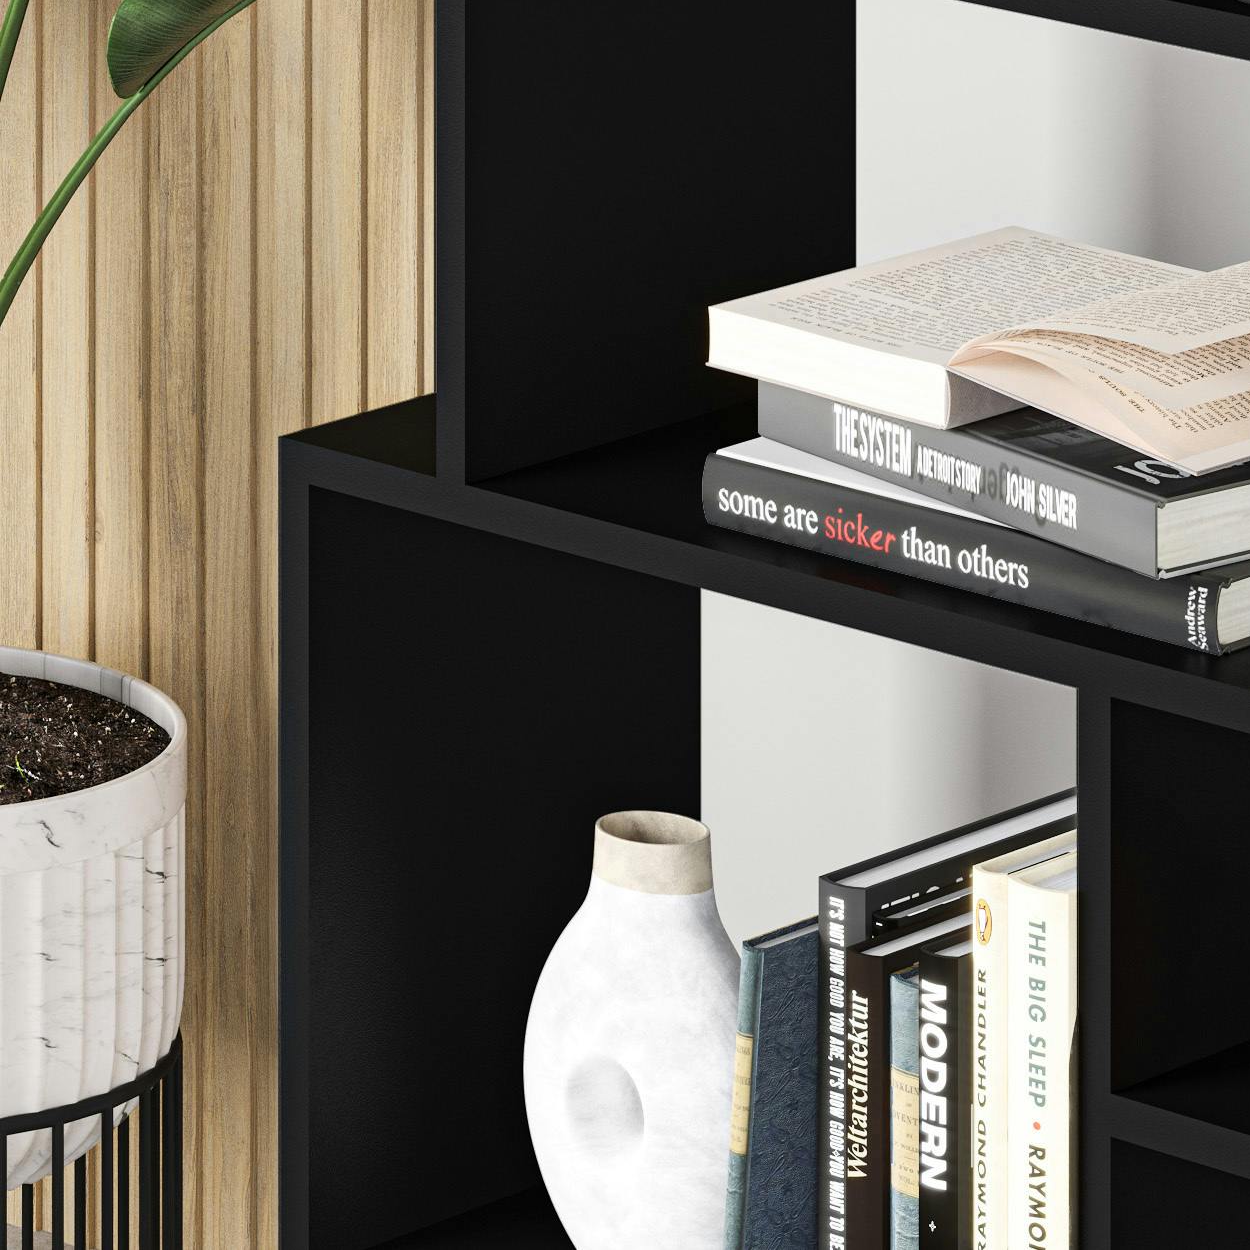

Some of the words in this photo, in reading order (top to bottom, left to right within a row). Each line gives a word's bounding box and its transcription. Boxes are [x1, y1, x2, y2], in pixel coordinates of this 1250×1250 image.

[833, 403, 858, 458] THE
[859, 412, 912, 478] SYSTEM
[1006, 471, 1036, 515] JOHN
[1038, 483, 1078, 530] SILVER
[717, 487, 778, 524] some
[783, 503, 819, 535] are
[824, 507, 897, 554] sicker
[901, 526, 952, 570] than
[957, 543, 1030, 590] others
[1185, 586, 1200, 647] Andrew
[829, 922, 845, 947] NOT
[1028, 921, 1047, 969] THE
[829, 948, 845, 976] HOW
[829, 977, 845, 1008] GOOD
[1028, 977, 1047, 1023] BIG
[829, 1012, 845, 1035] YOU
[977, 969, 987, 1107] CHANDLER
[847, 989, 869, 1178] Weltarchitektur
[920, 978, 948, 1192] MODERN
[1028, 1034, 1047, 1108] SLEEP
[829, 1091, 845, 1119] HOW
[829, 1120, 845, 1152] GOOD
[829, 1152, 845, 1178] YOU
[829, 1181, 845, 1214] WANT
[1028, 1144, 1047, 1250] RAYMO
[829, 1217, 845, 1231] TO
